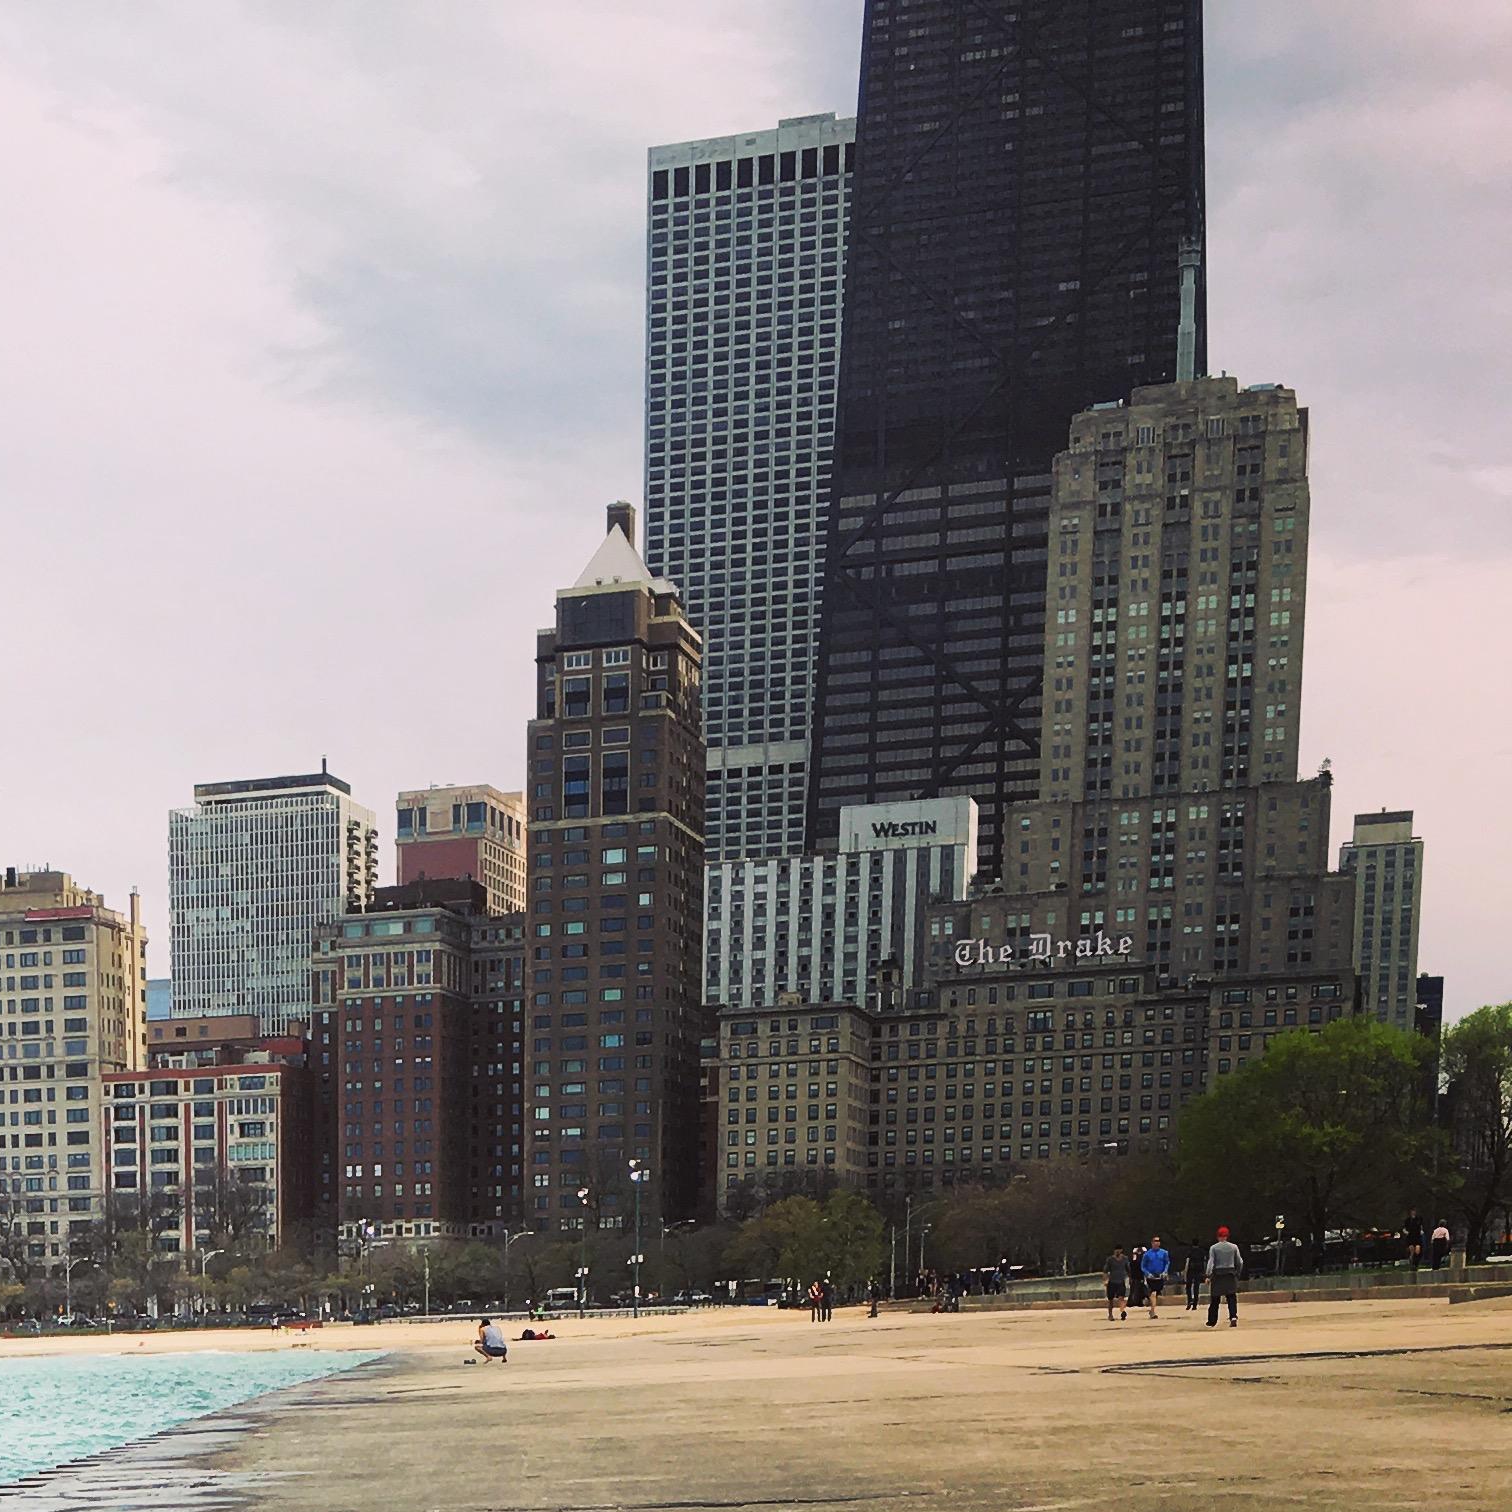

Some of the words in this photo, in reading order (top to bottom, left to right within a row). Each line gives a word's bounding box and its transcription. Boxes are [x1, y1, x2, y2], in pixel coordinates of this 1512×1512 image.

[872, 821, 937, 838] WESTIN
[955, 939, 1013, 966] The
[1029, 930, 1133, 959] Drake
